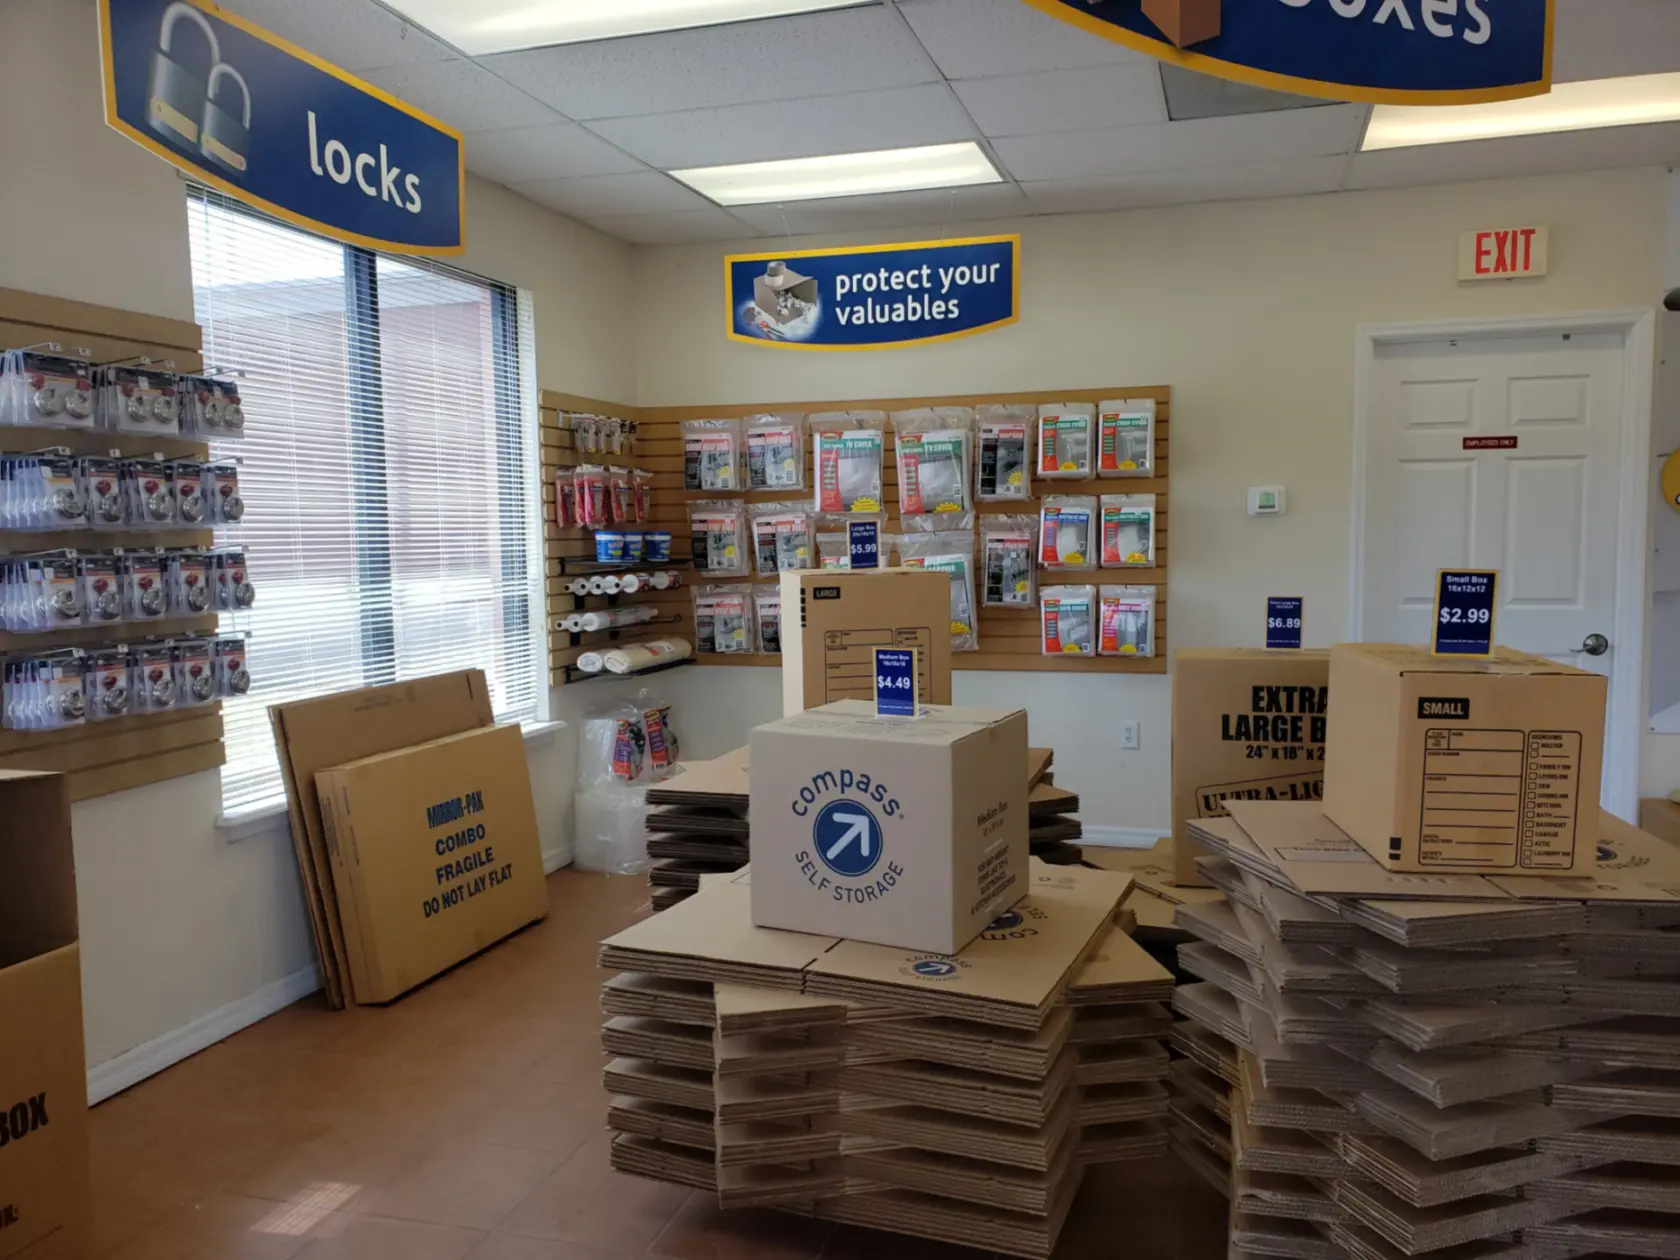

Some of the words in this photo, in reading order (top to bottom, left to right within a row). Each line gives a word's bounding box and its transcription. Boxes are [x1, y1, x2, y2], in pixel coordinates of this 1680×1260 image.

[1276, 0, 1492, 45] xes
[307, 110, 422, 215] locks
[1475, 228, 1536, 274] EXIT
[835, 263, 932, 301] protect
[938, 262, 1001, 294] your
[835, 293, 960, 326] valuables
[851, 543, 877, 554] $5.99
[816, 587, 838, 597] LARGE
[1268, 617, 1301, 628] $6.89
[1440, 607, 1490, 624] $2.99
[878, 675, 911, 689] $4.49
[1252, 685, 1328, 713] EXTRA
[1423, 702, 1464, 715] SMALL
[1222, 714, 1303, 742] LARGE
[792, 769, 901, 817] compass
[427, 791, 484, 829] MIRROR-PAK
[435, 824, 486, 856] COMBO
[436, 847, 495, 885] FRAGILE
[795, 850, 832, 891] SELF
[833, 861, 904, 904] STORAGE
[423, 898, 440, 918] DO
[441, 885, 465, 910] NOT
[466, 873, 487, 898] LAY
[488, 863, 513, 888] FLAT
